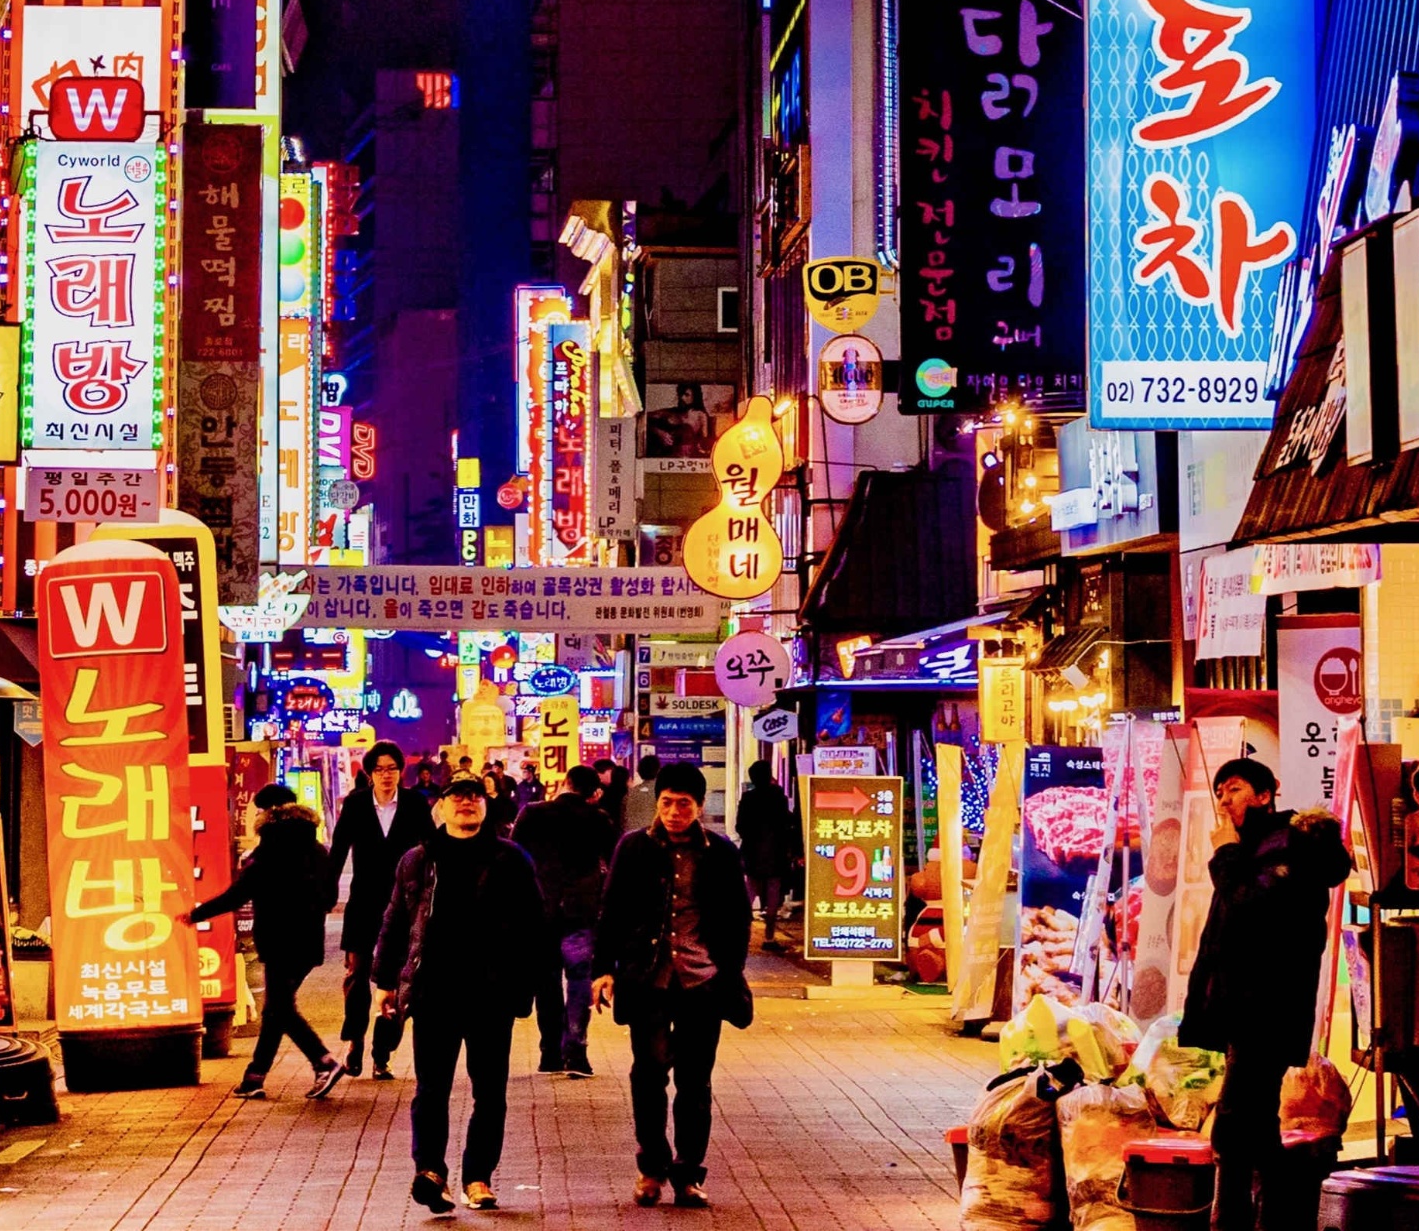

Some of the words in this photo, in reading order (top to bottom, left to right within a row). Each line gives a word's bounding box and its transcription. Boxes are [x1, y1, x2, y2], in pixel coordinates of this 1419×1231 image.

[66, 88, 128, 132] W
[58, 154, 120, 168] Cyworld
[912, 89, 956, 341] 치킨전문점
[198, 183, 239, 327] 해물떡찜
[44, 173, 148, 414] 노래방
[811, 264, 873, 294] OB
[1141, 376, 1258, 404] 732-8929
[45, 421, 139, 443] 최신시설
[555, 426, 584, 544] 노래방
[722, 463, 760, 580] 월매네
[59, 581, 146, 648] W
[672, 700, 719, 709] SOLDESK
[59, 668, 178, 953] 노래방
[815, 819, 893, 840] 퓨전포차
[835, 845, 867, 897] 9
[81, 960, 167, 980] 최신시설
[81, 980, 169, 1001] 녹음무료
[68, 998, 188, 1021] 세계각국노래
